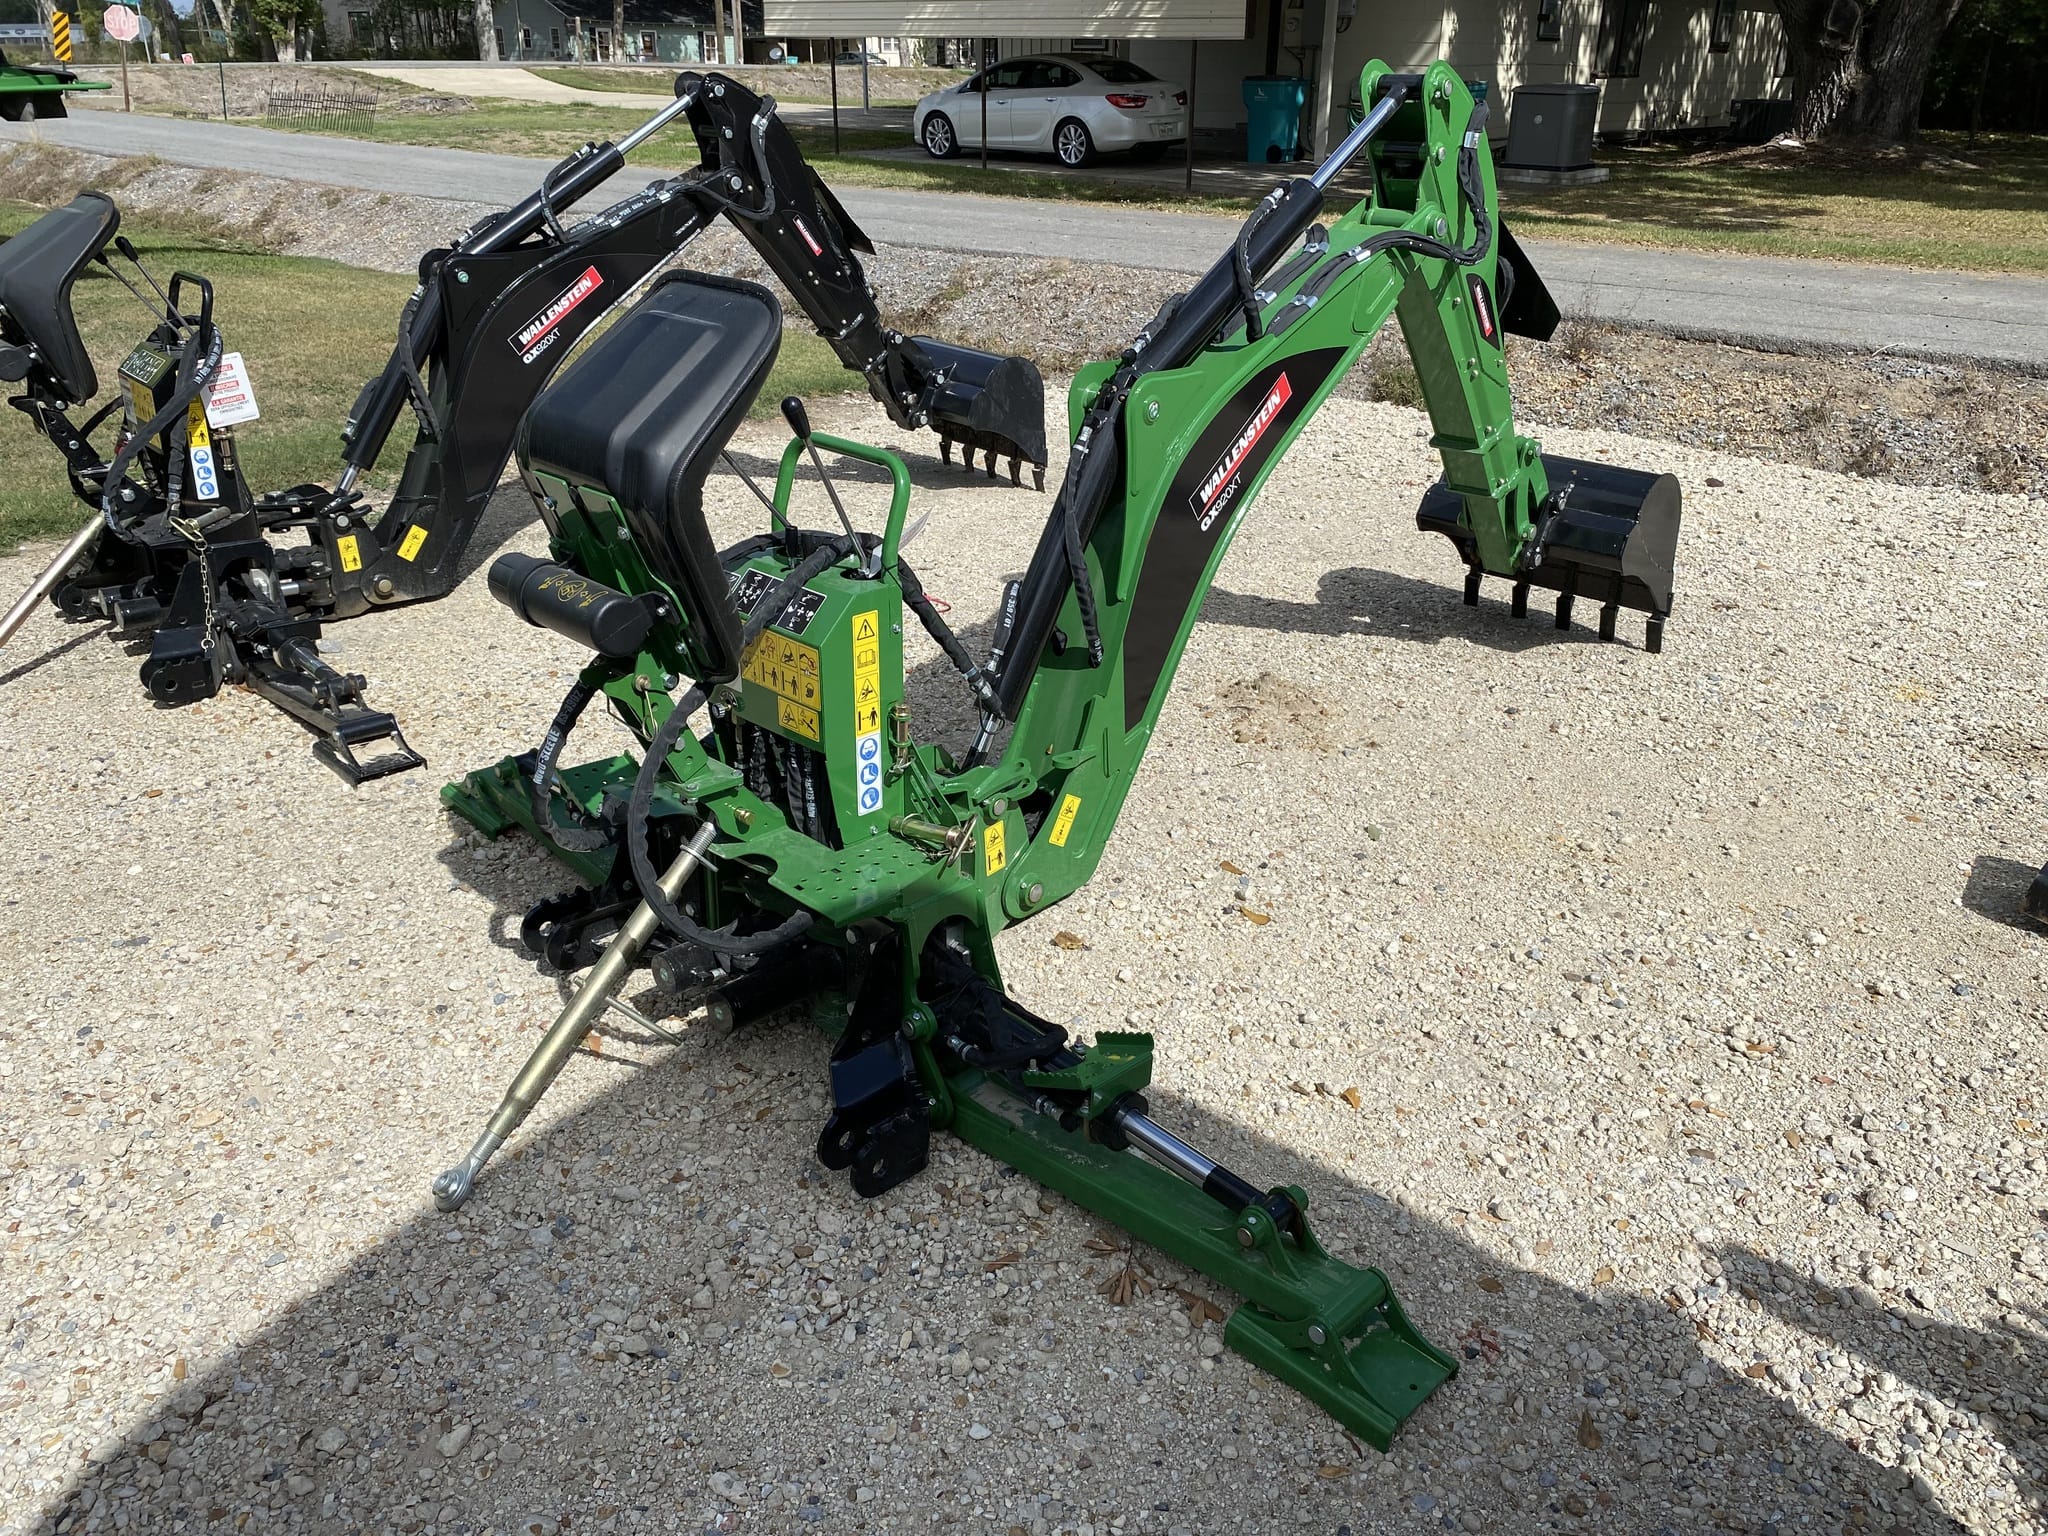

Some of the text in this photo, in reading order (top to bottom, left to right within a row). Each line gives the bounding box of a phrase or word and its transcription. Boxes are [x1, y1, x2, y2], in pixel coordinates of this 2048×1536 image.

[106, 14, 136, 29] STOP
[518, 276, 593, 345] WALLENSTEIN
[523, 327, 561, 364] GX920XT
[1199, 389, 1281, 504] WALLENSTEIN
[1200, 472, 1242, 532] GX920XT
